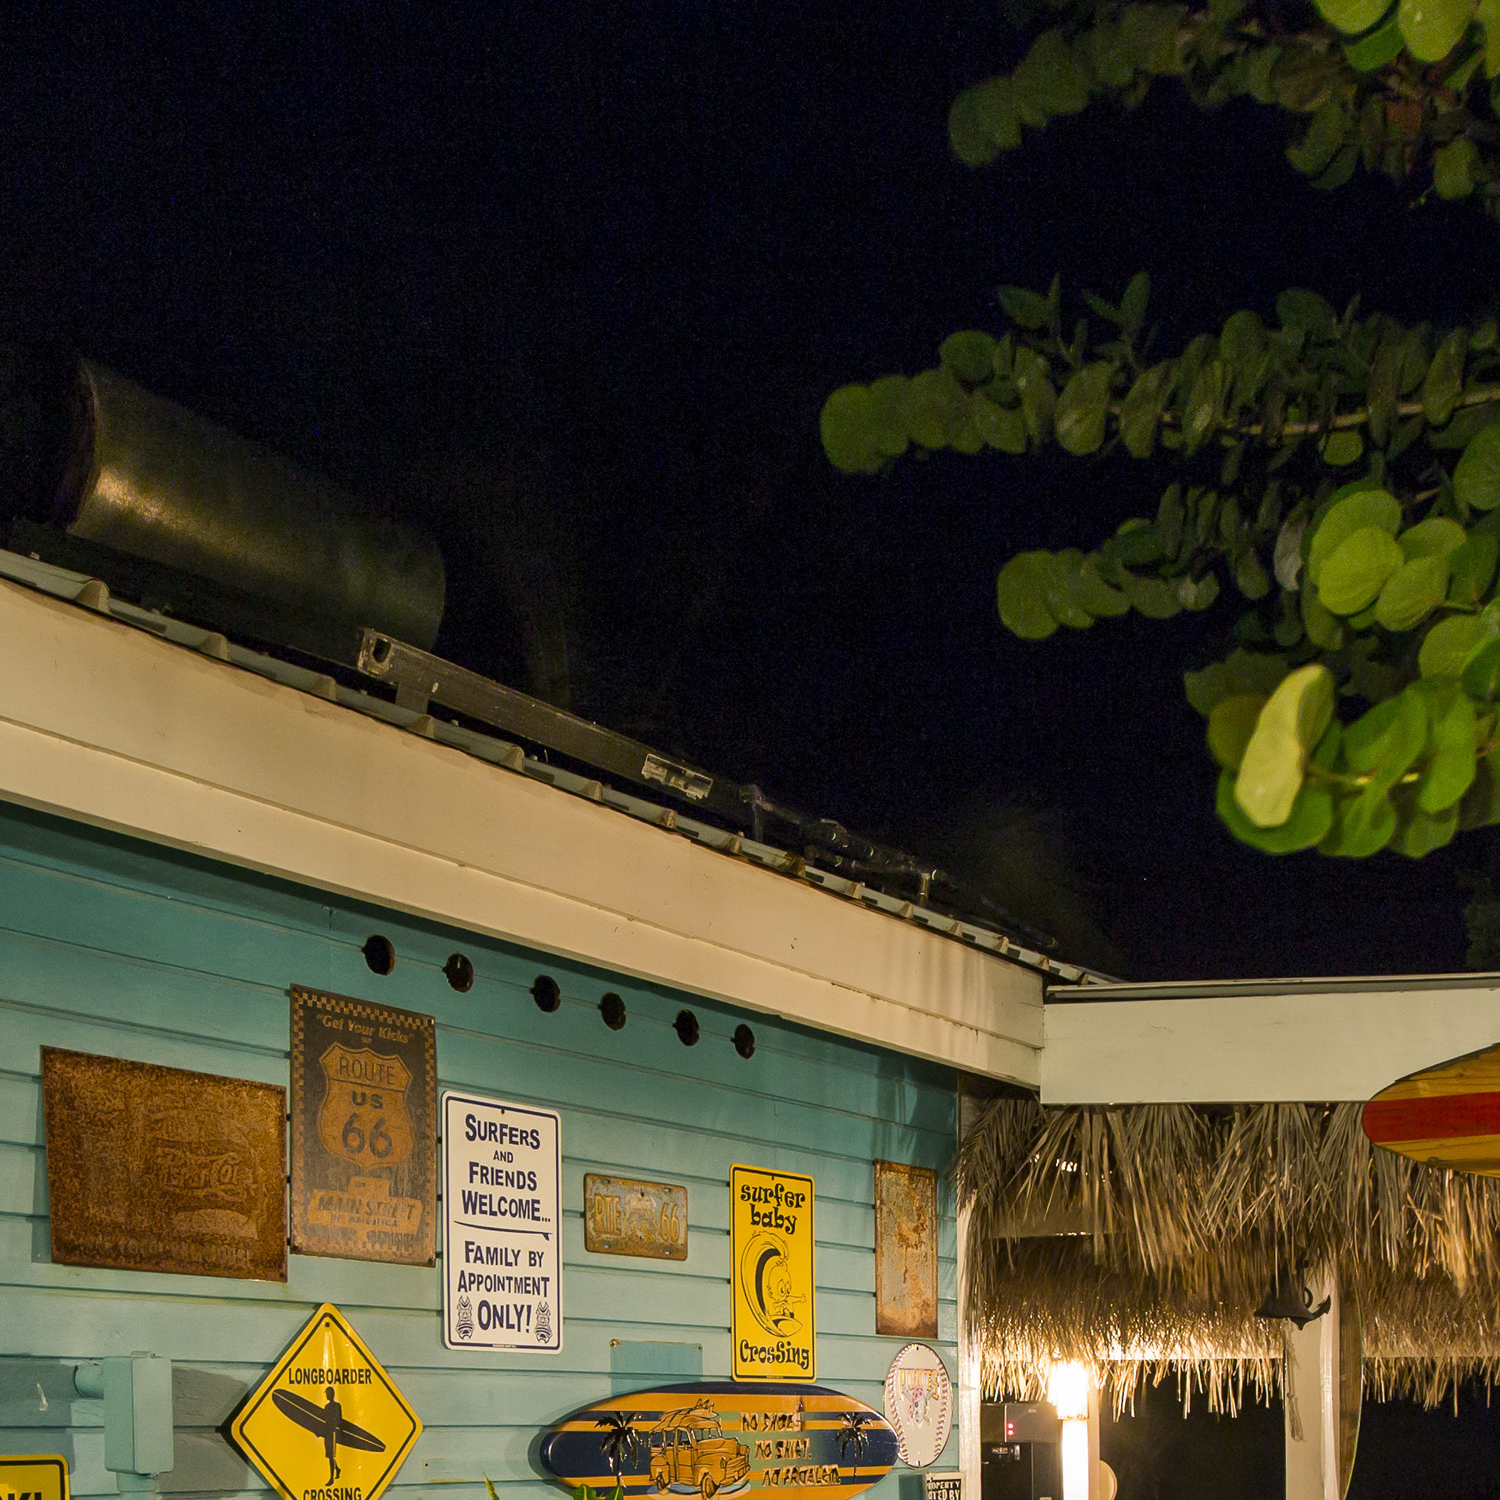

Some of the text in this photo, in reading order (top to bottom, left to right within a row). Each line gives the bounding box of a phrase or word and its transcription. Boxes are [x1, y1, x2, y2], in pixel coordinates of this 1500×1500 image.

[348, 1020, 376, 1036] Your
[339, 1056, 396, 1086] ROUTE
[351, 1091, 383, 1110] US
[342, 1112, 393, 1159] 66
[465, 1114, 541, 1150] SURFERS
[493, 1150, 514, 1164] AND
[468, 1161, 537, 1192] FRIENDS
[461, 1190, 551, 1223] WELCOME...
[740, 1183, 806, 1209] surfer
[594, 1194, 680, 1243] RTE 66
[749, 1203, 797, 1235] baby
[464, 1240, 545, 1268] FAMILY BY
[457, 1269, 550, 1298] APPOINTMENT
[477, 1299, 532, 1334] ONLY!
[288, 1367, 373, 1385] LONGBOARDER
[740, 1411, 758, 1432] NO
[755, 1439, 773, 1460] NO
[762, 1466, 780, 1487] NO
